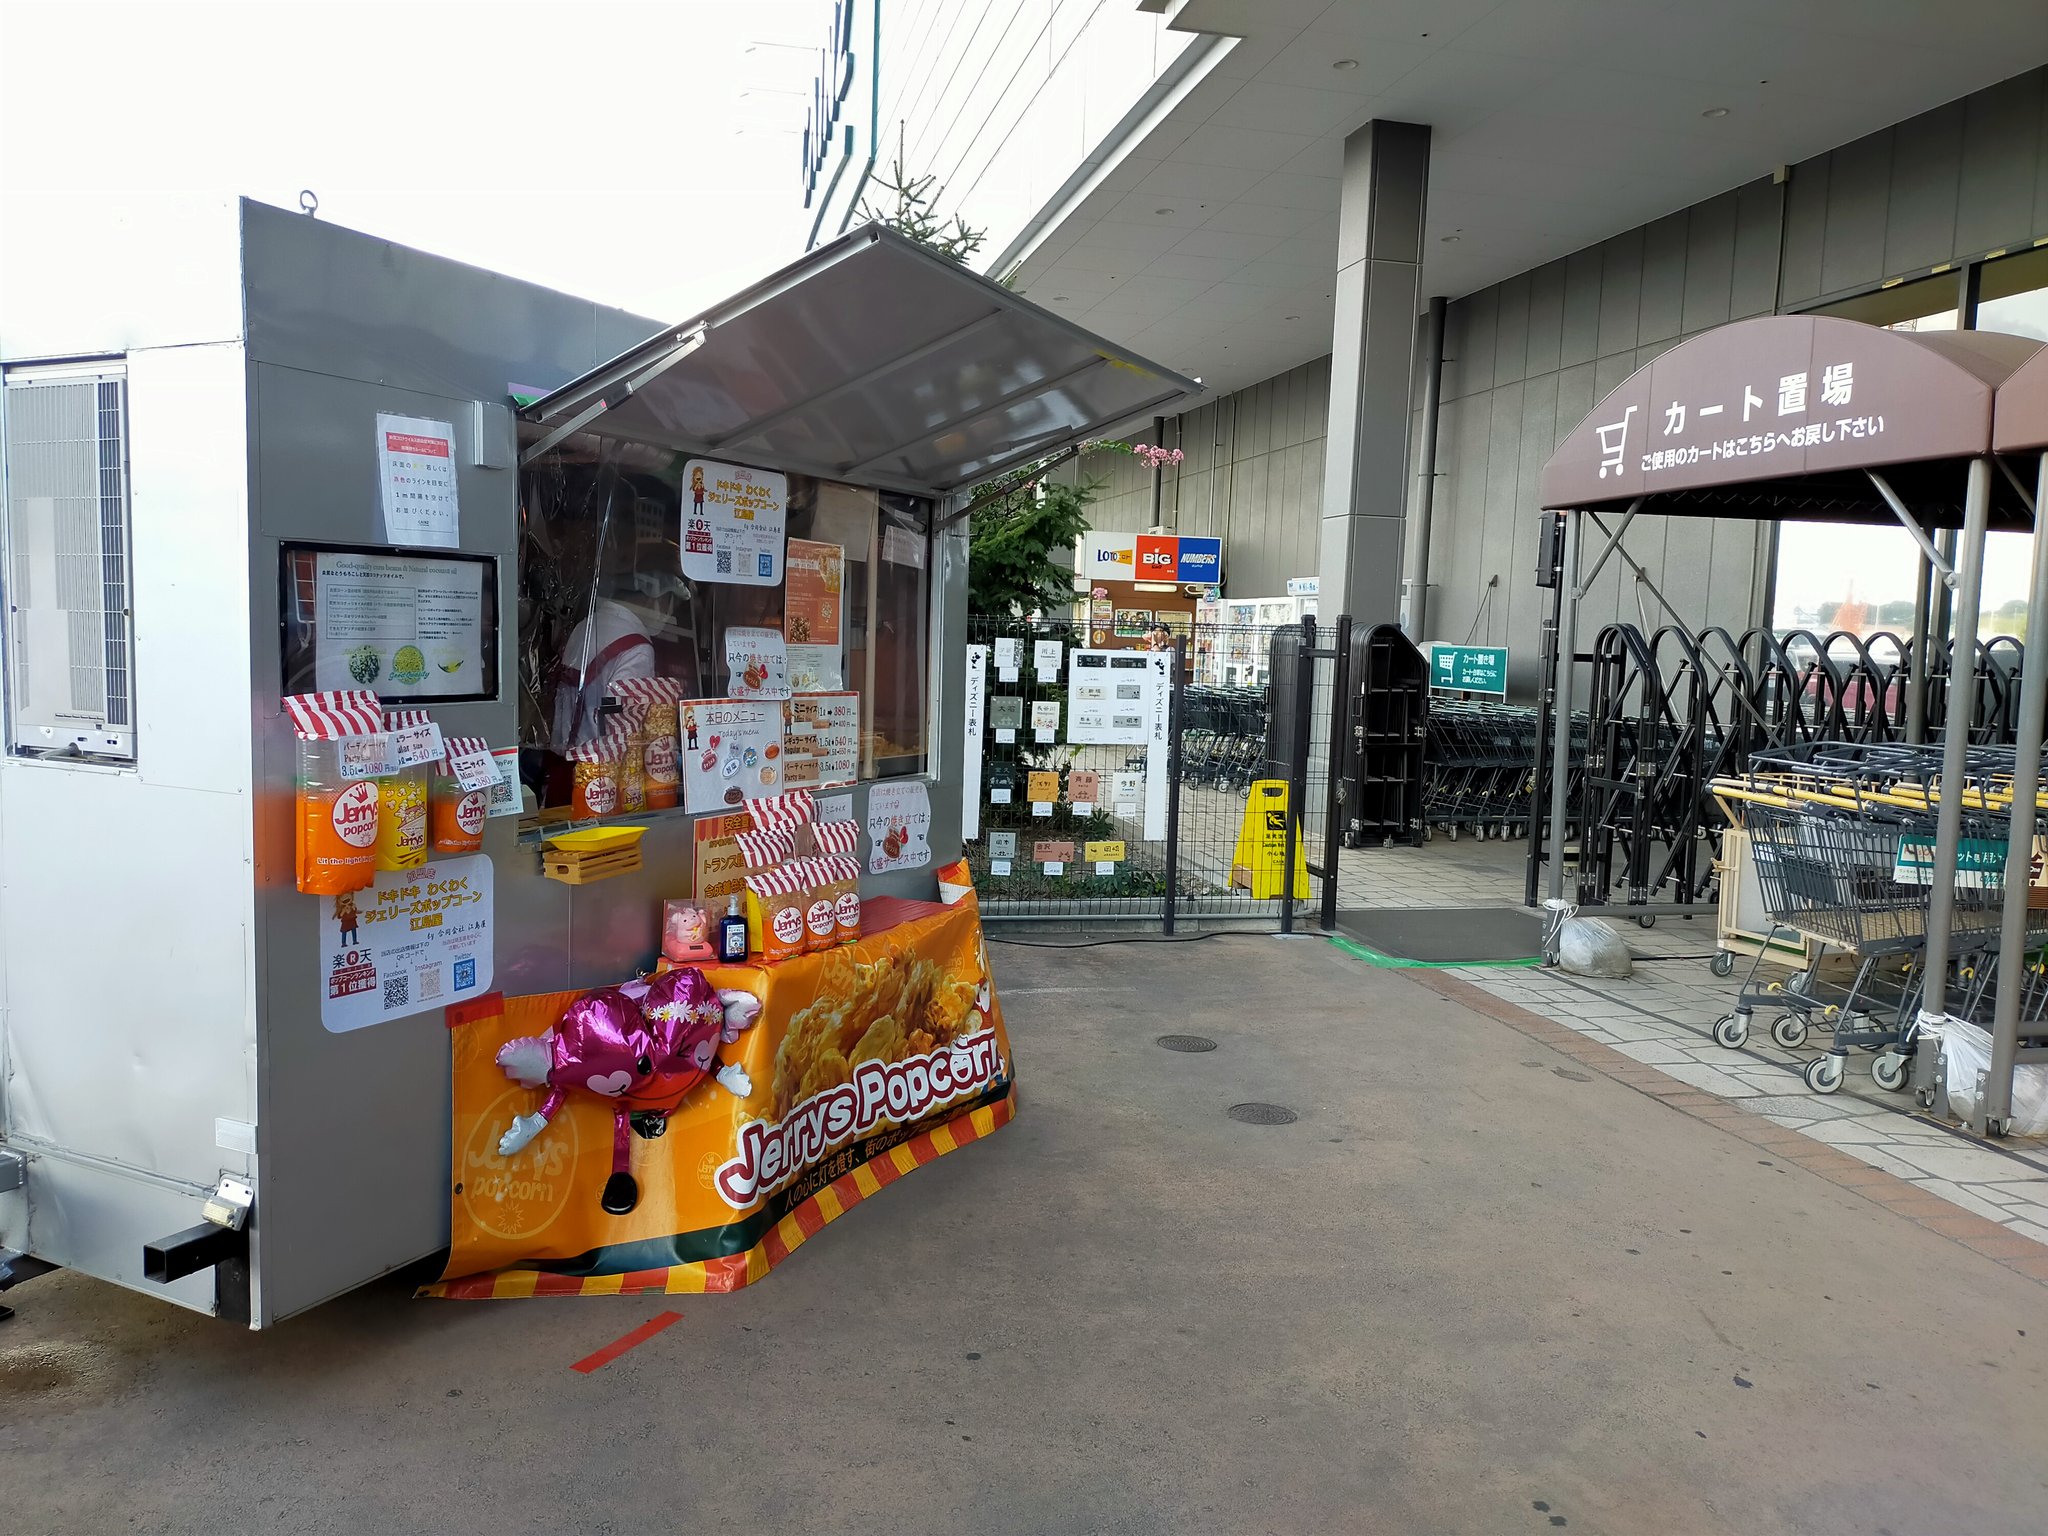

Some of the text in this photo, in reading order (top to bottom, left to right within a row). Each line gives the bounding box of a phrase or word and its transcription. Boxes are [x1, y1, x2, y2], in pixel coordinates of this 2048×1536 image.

[1664, 362, 1854, 436] カート置場
[1641, 414, 1884, 472] ご使用のカートはこちらへお戻し下さい
[1142, 551, 1172, 565] BIG
[1180, 553, 1217, 564] NUMBERS
[968, 677, 979, 736] ディズニー表札
[1154, 683, 1165, 740] ディズニー表札
[705, 710, 764, 725] 本日のメニュー
[455, 759, 486, 771] ミニサイズ
[586, 787, 616, 800] Jerrys
[335, 800, 378, 825] Jerrys
[396, 834, 423, 848] Jerrys
[317, 857, 328, 865] Lit
[329, 857, 343, 865] the
[870, 850, 930, 870] 大盛サービス中です
[377, 876, 468, 905] ドキドキ わくわく
[365, 891, 482, 924] ジェリーズポップコーン
[807, 908, 833, 924] Jerrys
[835, 901, 859, 916] Jerrys
[774, 916, 802, 933] Jerrys
[383, 968, 408, 978] Facebook
[414, 959, 443, 972] Instagram
[718, 1087, 856, 1204] Jerrys
